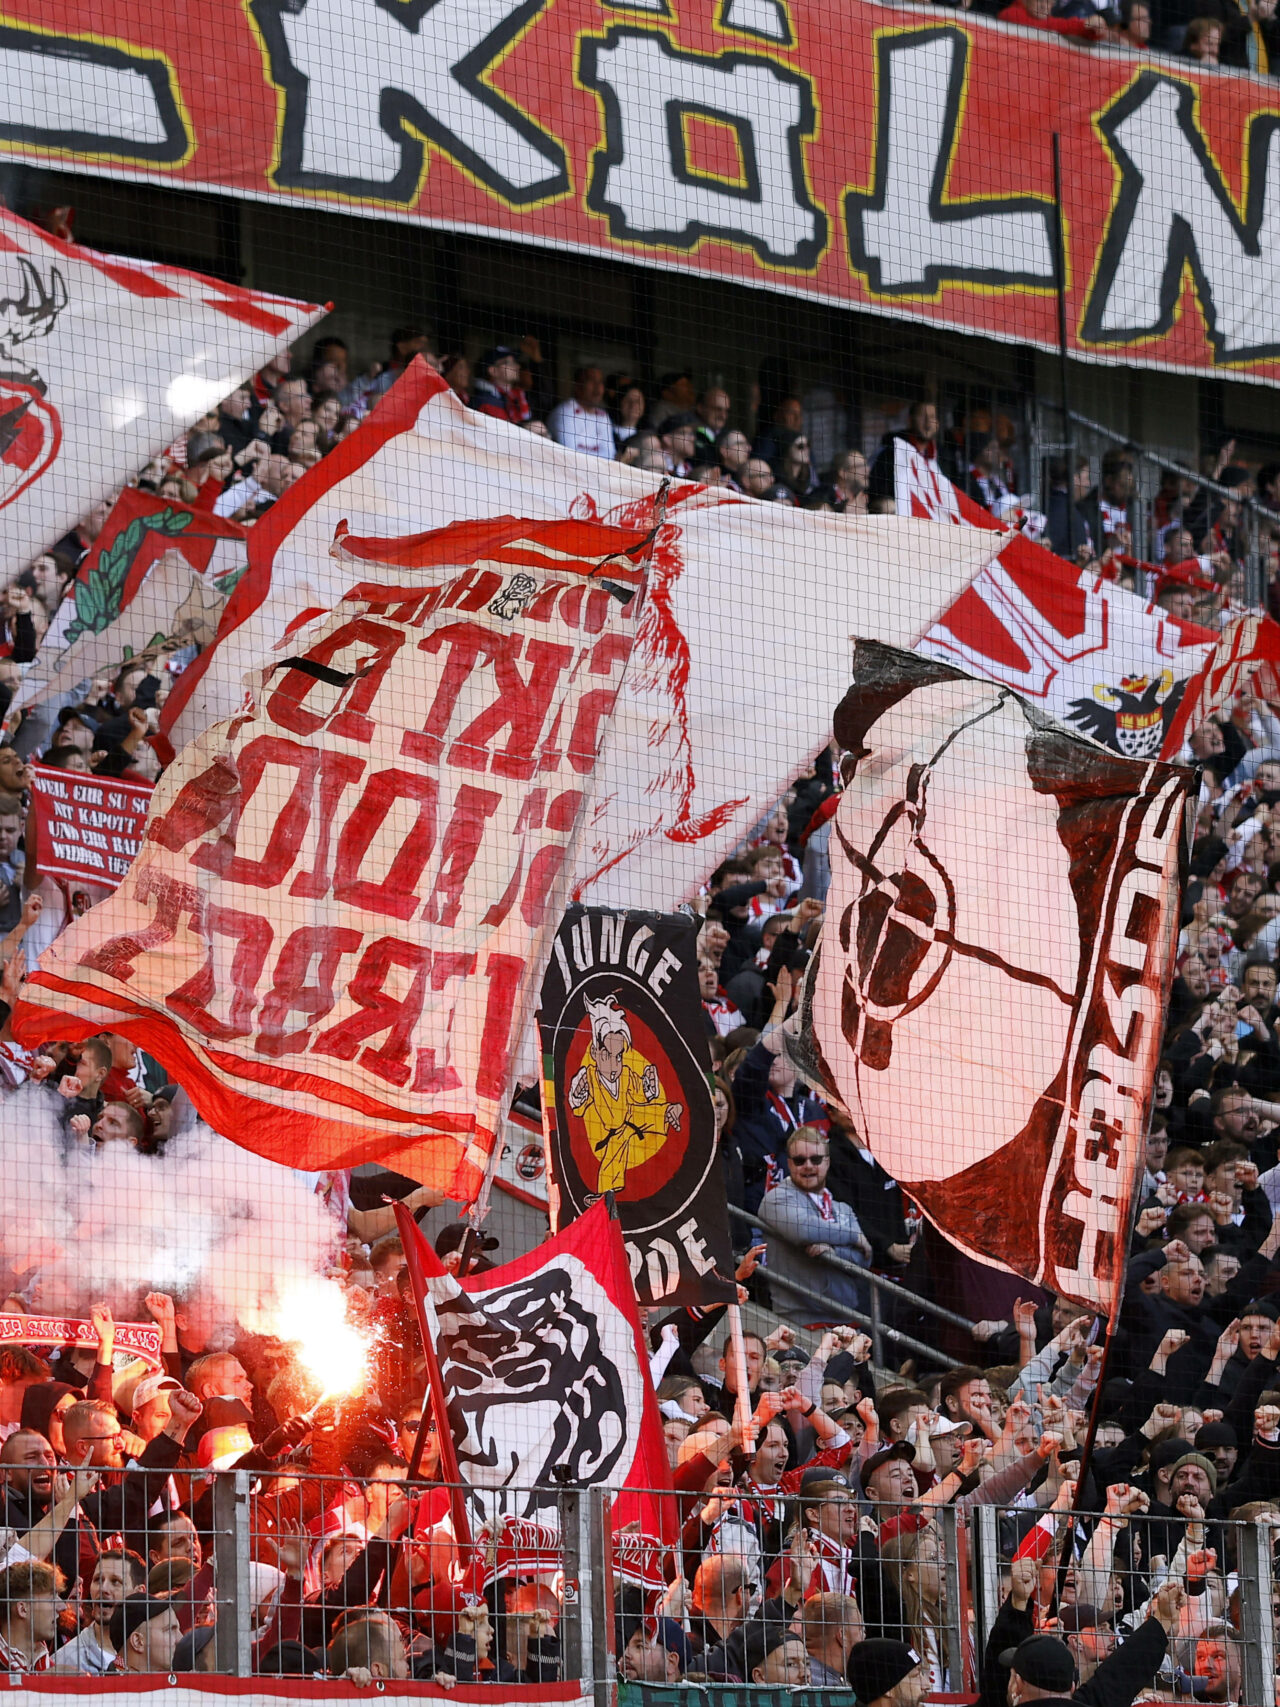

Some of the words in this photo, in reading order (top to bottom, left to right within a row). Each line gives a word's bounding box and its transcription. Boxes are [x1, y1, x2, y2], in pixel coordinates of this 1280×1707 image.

[250, 0, 1280, 365] KÖLN
[107, 791, 128, 810] SU
[47, 820, 80, 841] UND
[78, 807, 137, 835] KAPOTT
[51, 840, 105, 869] WIDDER
[553, 912, 683, 998] JUNGE
